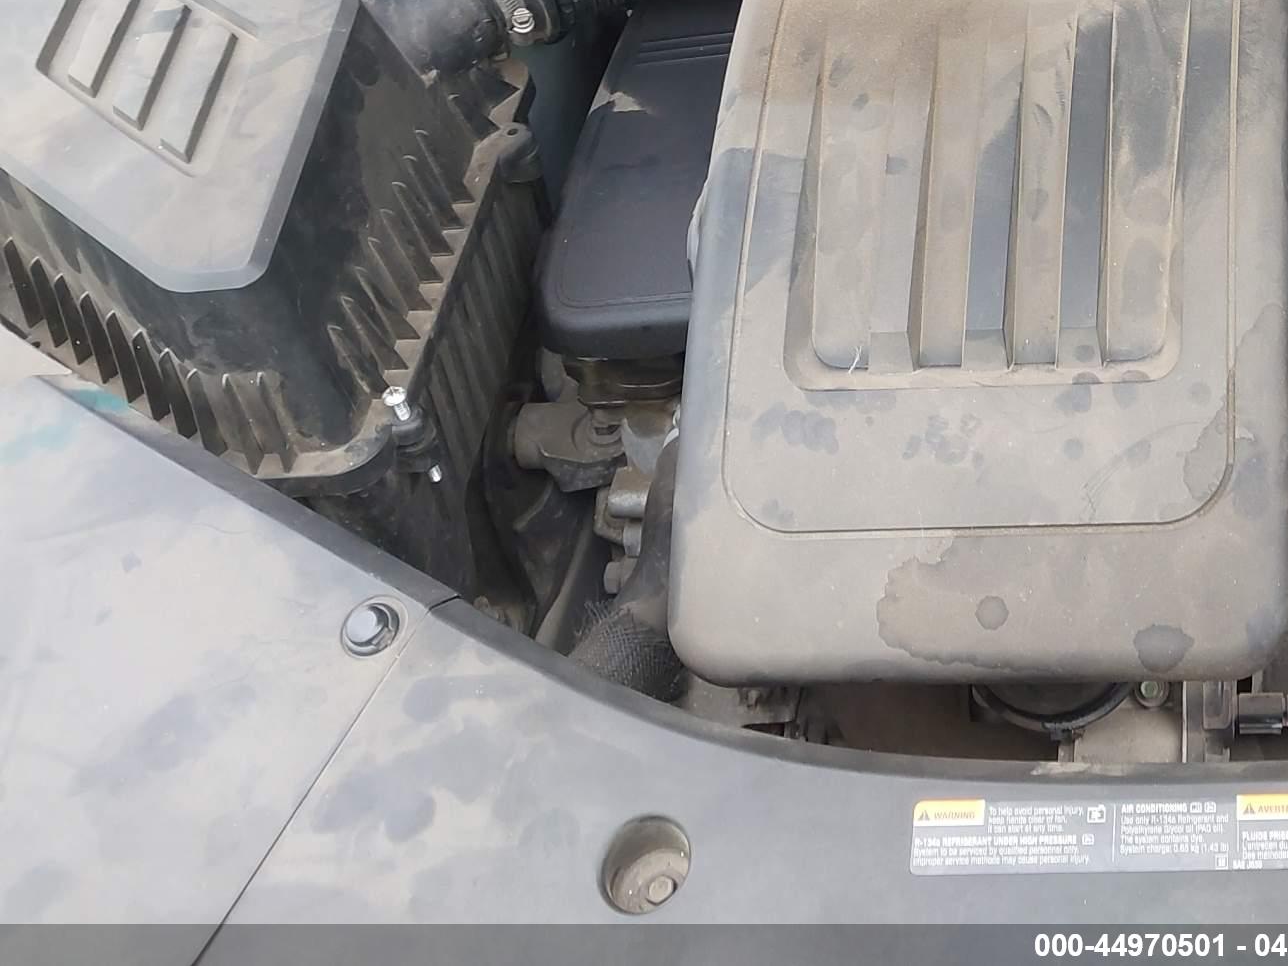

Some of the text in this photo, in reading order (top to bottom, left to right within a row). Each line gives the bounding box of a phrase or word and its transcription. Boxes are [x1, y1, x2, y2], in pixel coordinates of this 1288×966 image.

[1121, 803, 1188, 814] AIR CONDITIONING
[934, 810, 976, 820] WARNING
[994, 835, 1019, 846] UNDER
